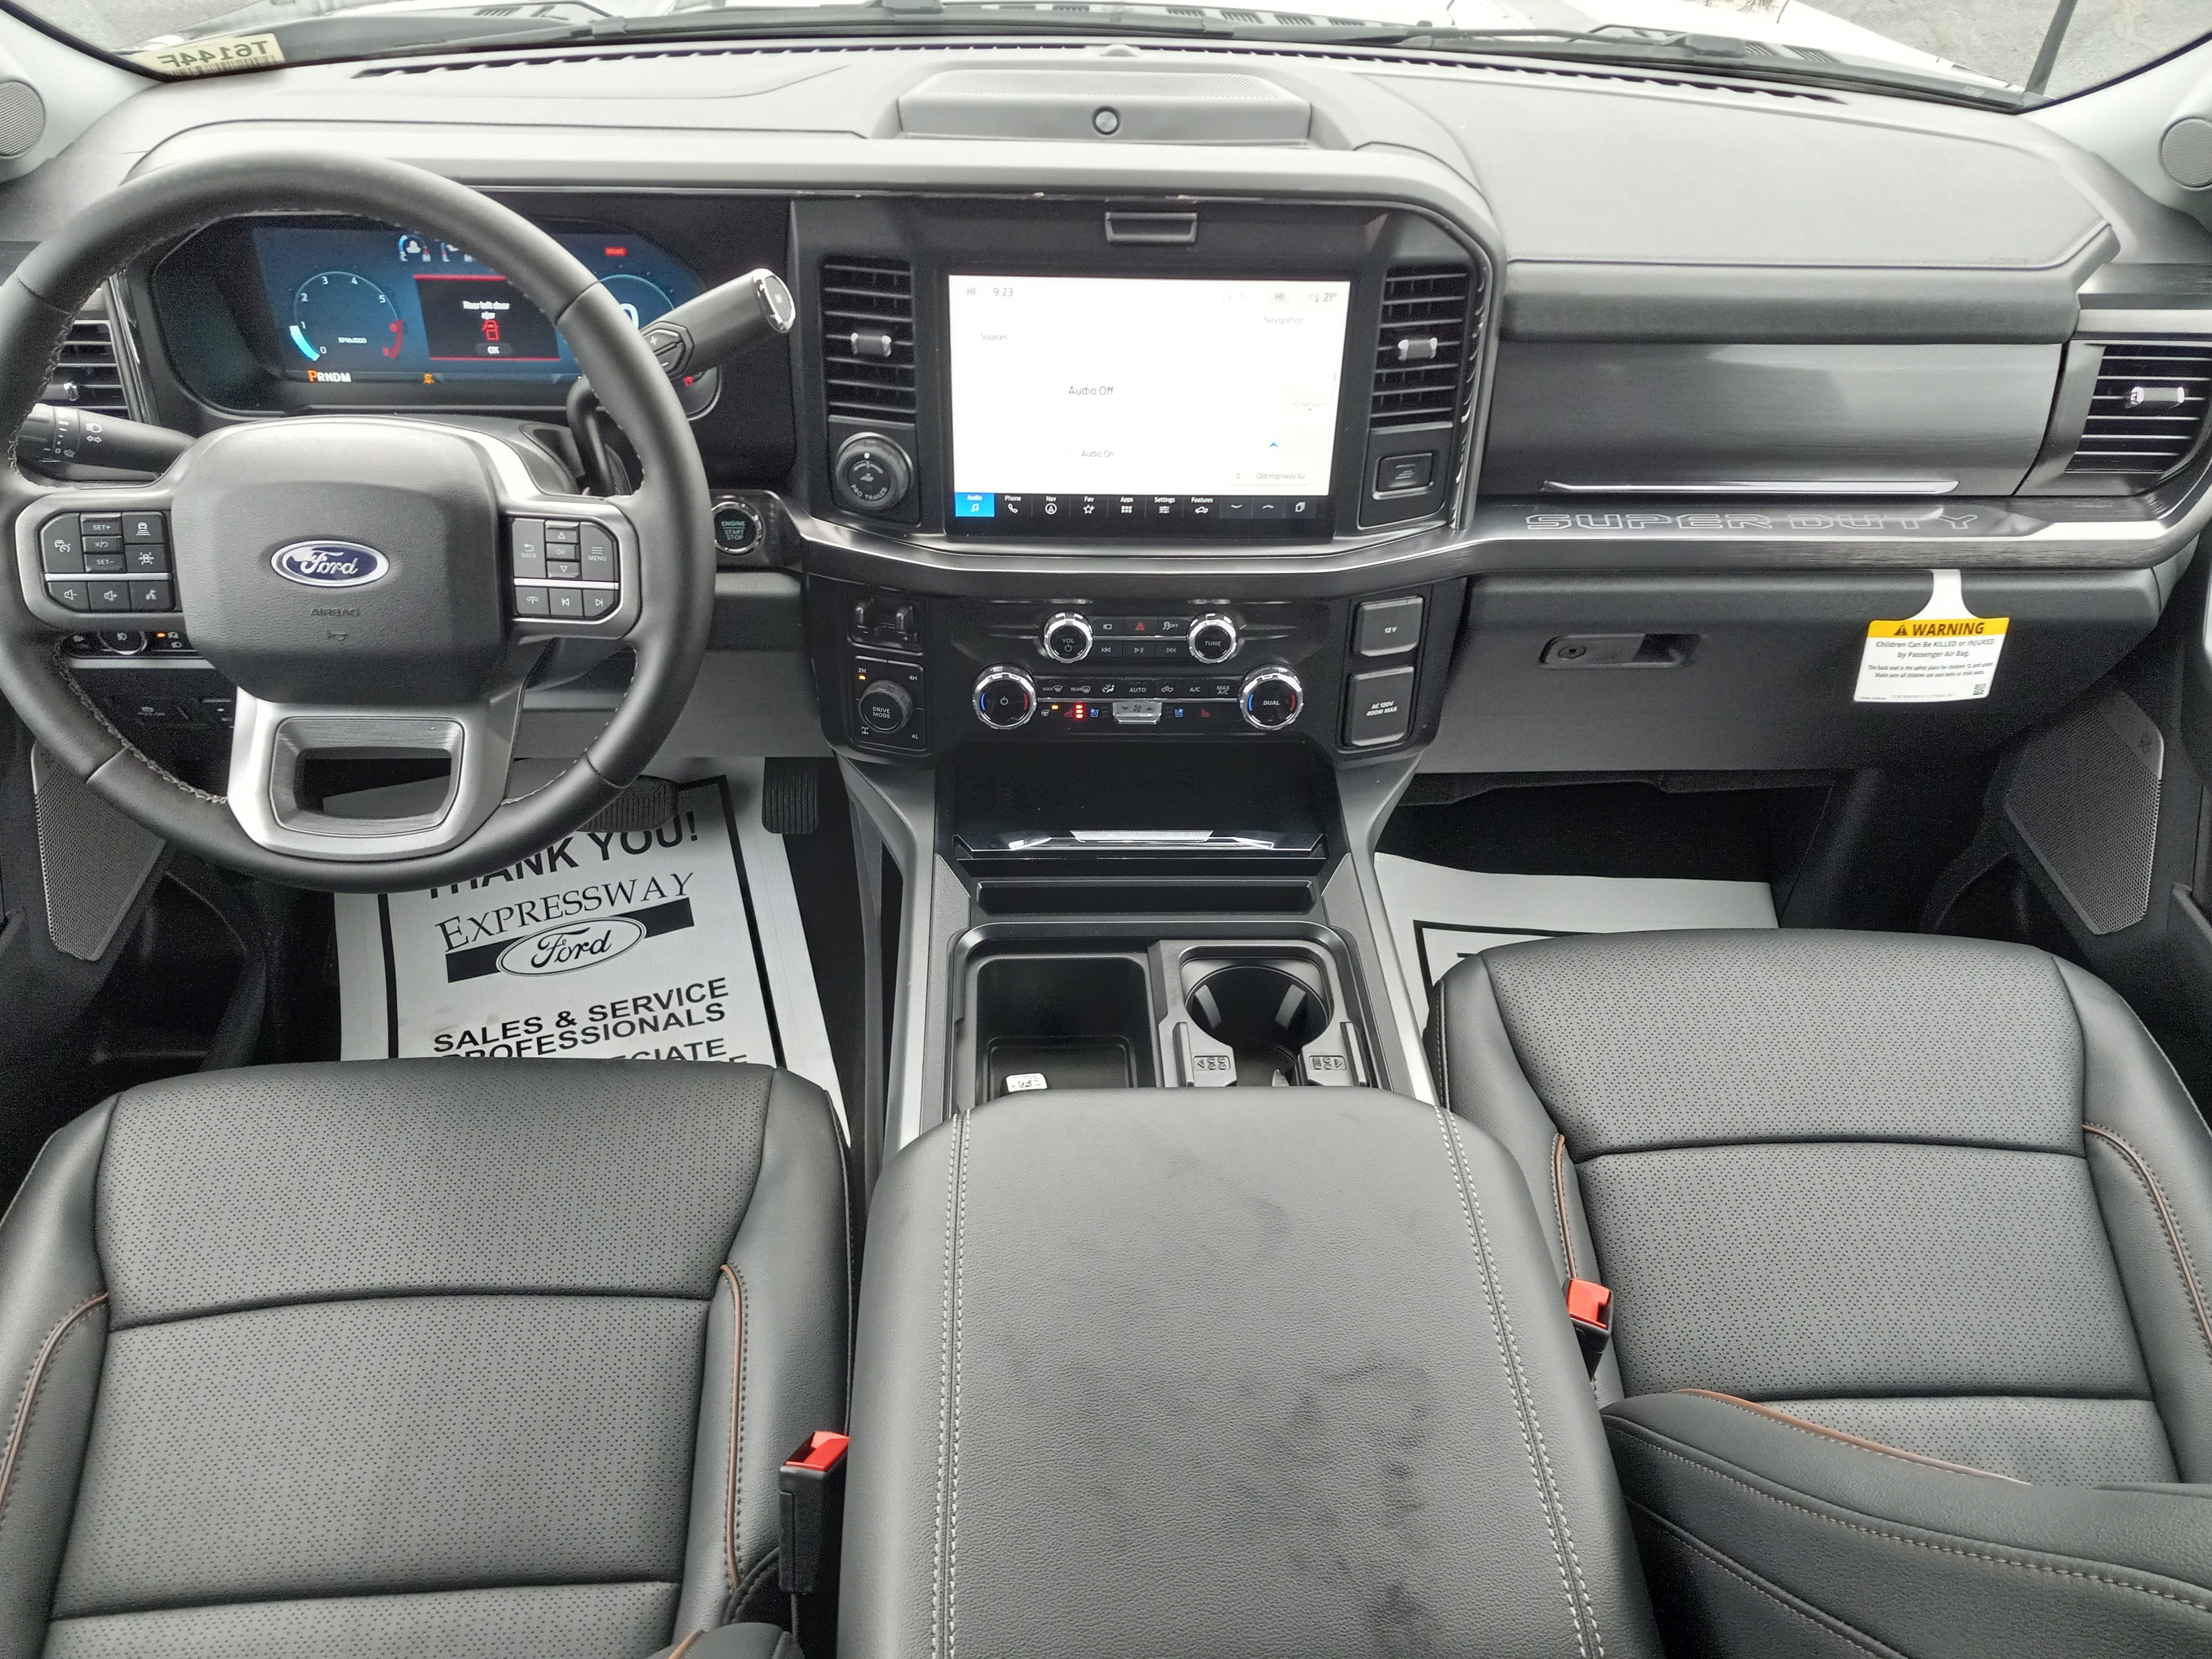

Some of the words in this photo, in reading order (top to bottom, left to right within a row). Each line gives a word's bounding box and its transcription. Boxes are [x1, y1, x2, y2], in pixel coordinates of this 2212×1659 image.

[322, 276, 328, 285] 3
[993, 288, 1013, 297] 9:23
[300, 293, 308, 302] 2
[379, 294, 386, 303] 5
[1264, 316, 1305, 325] Navigation
[320, 346, 327, 354] 0
[1069, 385, 1097, 395] Audio
[1099, 386, 1114, 395] Off
[1526, 514, 1773, 529] SUPER
[1791, 514, 1977, 529] DUTY
[300, 551, 359, 574] Ford
[311, 608, 359, 616] AIRBAG
[1912, 622, 1985, 636] WARNING
[1380, 700, 1395, 709] 120V
[434, 872, 694, 953] EXPRESSWAY
[530, 926, 613, 969] Ford
[434, 1017, 543, 1052] SALES
[555, 1010, 577, 1028] &
[588, 977, 729, 1023] SERVICE
